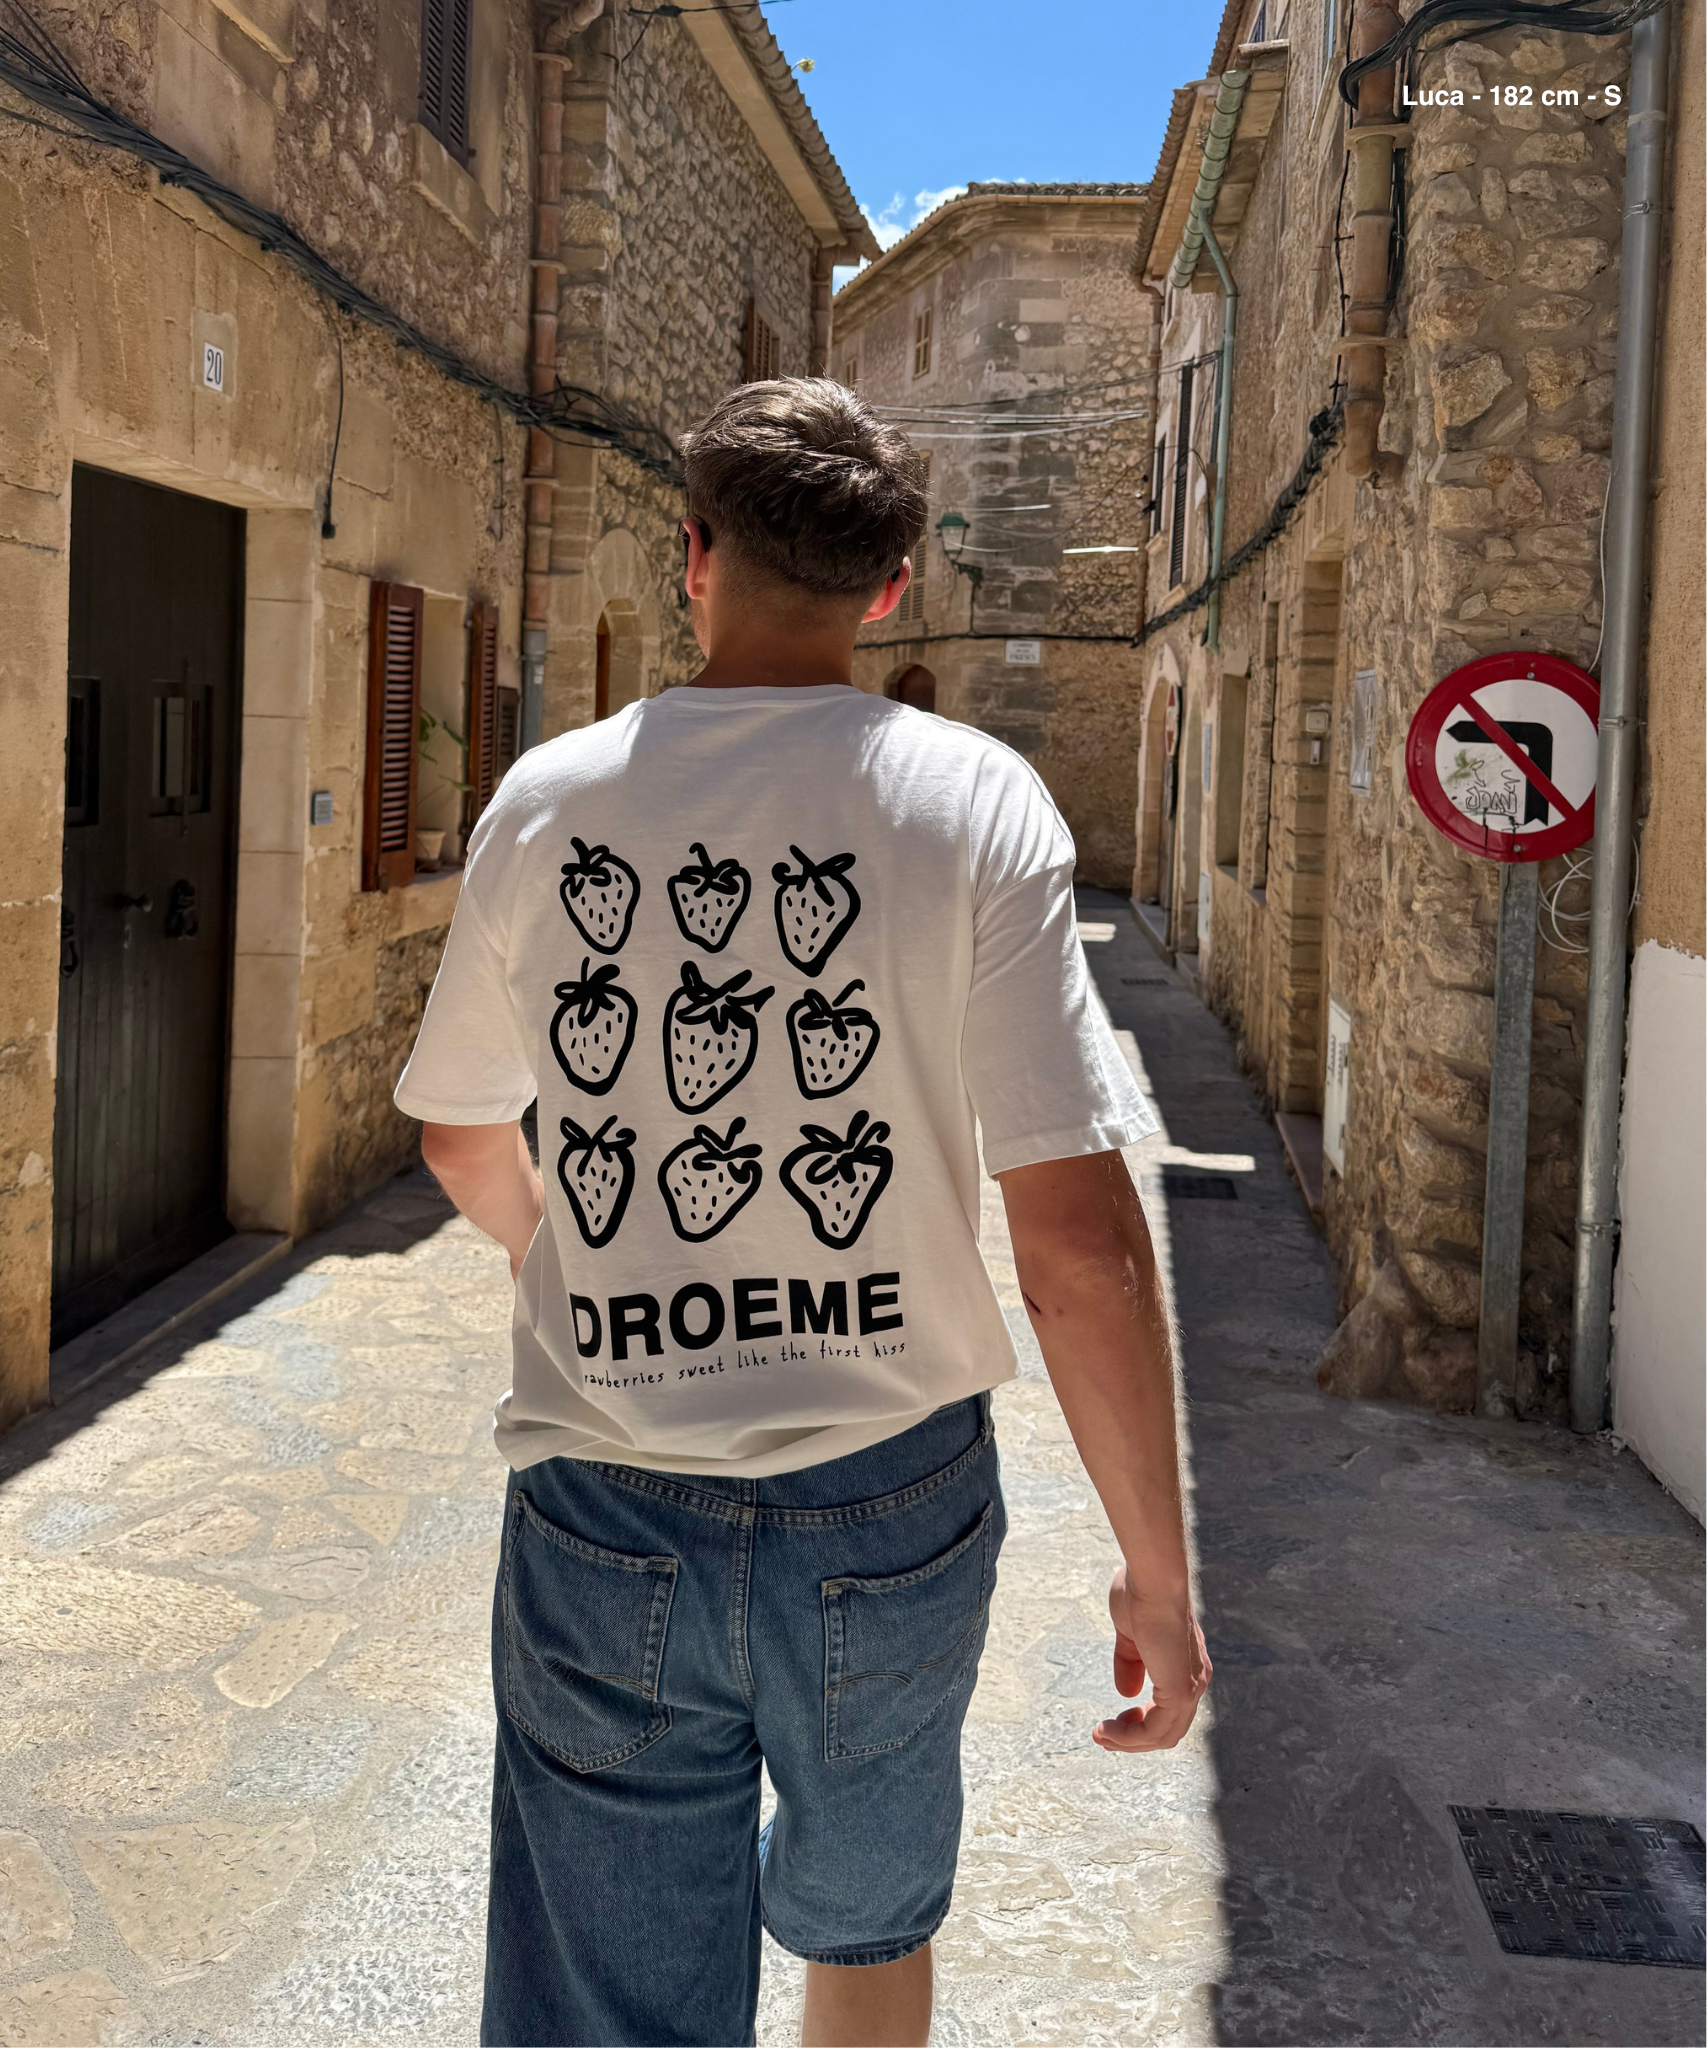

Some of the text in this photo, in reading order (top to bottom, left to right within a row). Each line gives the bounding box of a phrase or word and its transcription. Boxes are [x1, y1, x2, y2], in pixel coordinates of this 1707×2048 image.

[206, 348, 222, 386] 20
[569, 1271, 904, 1361] DROEME
[678, 1355, 726, 1380] sweet
[737, 1348, 769, 1369] like
[780, 1341, 807, 1362] the
[819, 1339, 861, 1360] first
[873, 1341, 906, 1358] kiss
